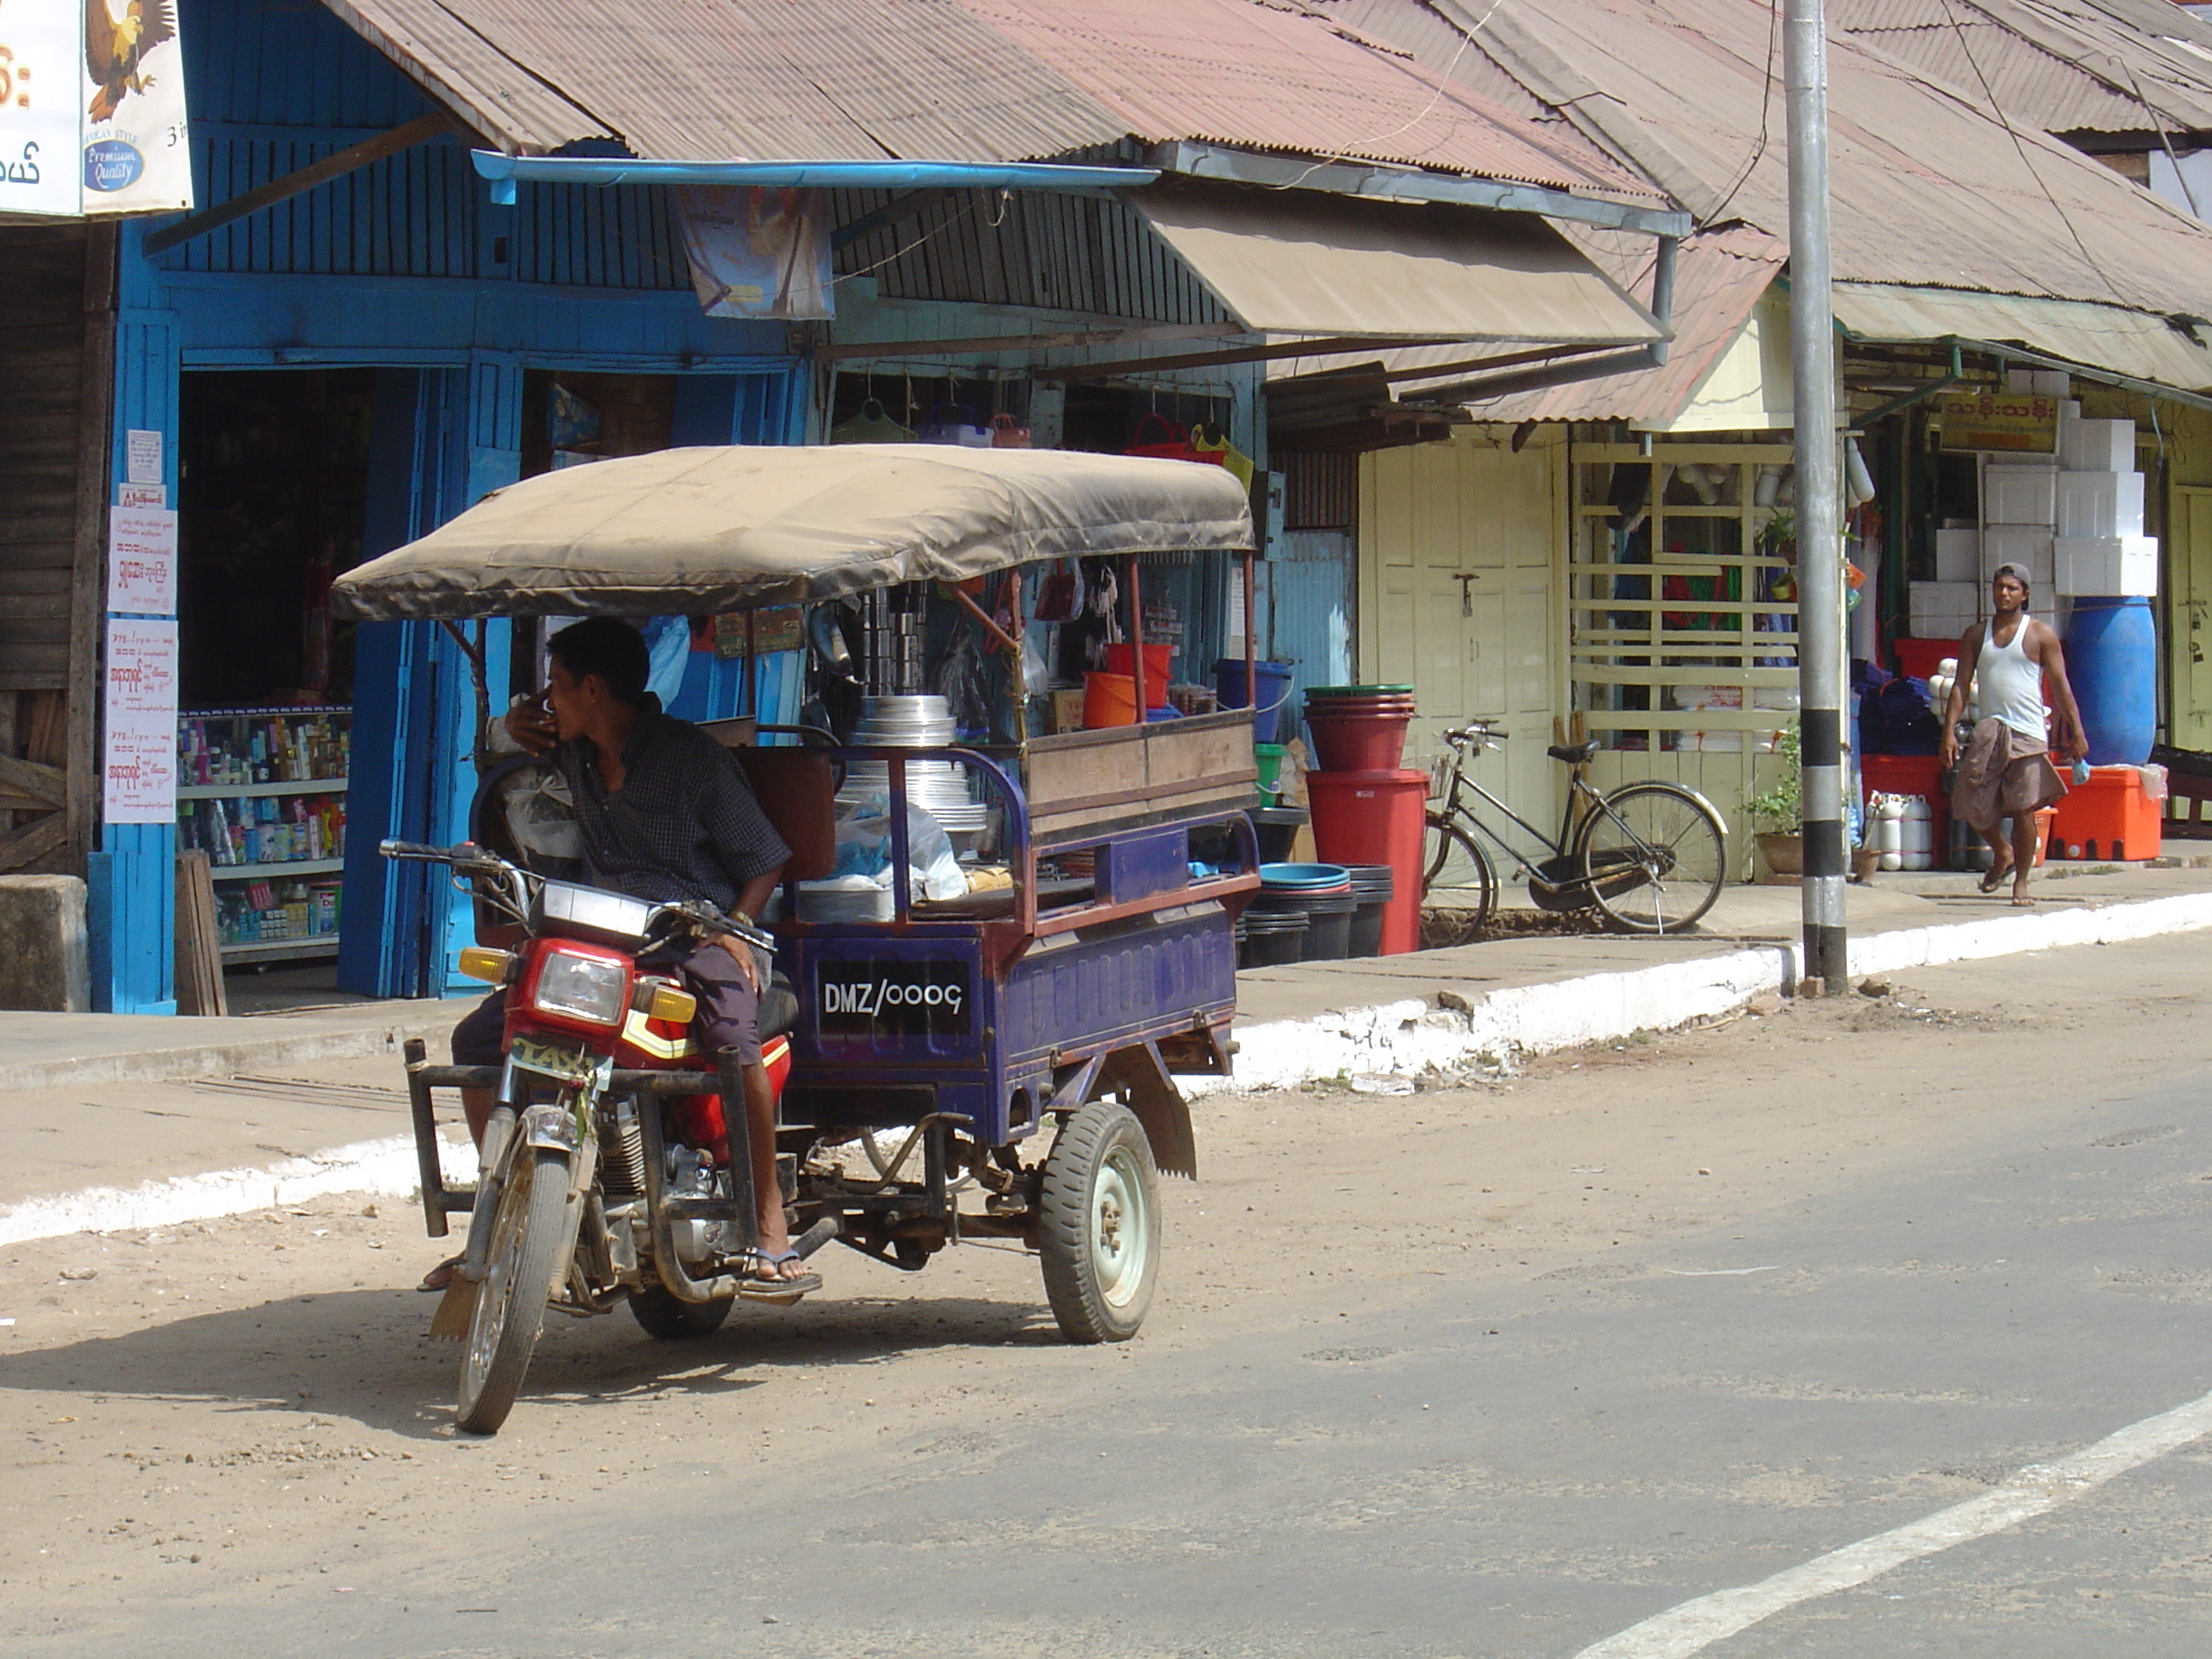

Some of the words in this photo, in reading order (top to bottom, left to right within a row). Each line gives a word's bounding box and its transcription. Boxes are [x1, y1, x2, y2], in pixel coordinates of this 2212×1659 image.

[167, 126, 177, 147] 3
[87, 146, 137, 163] Premium
[96, 163, 133, 189] Quality
